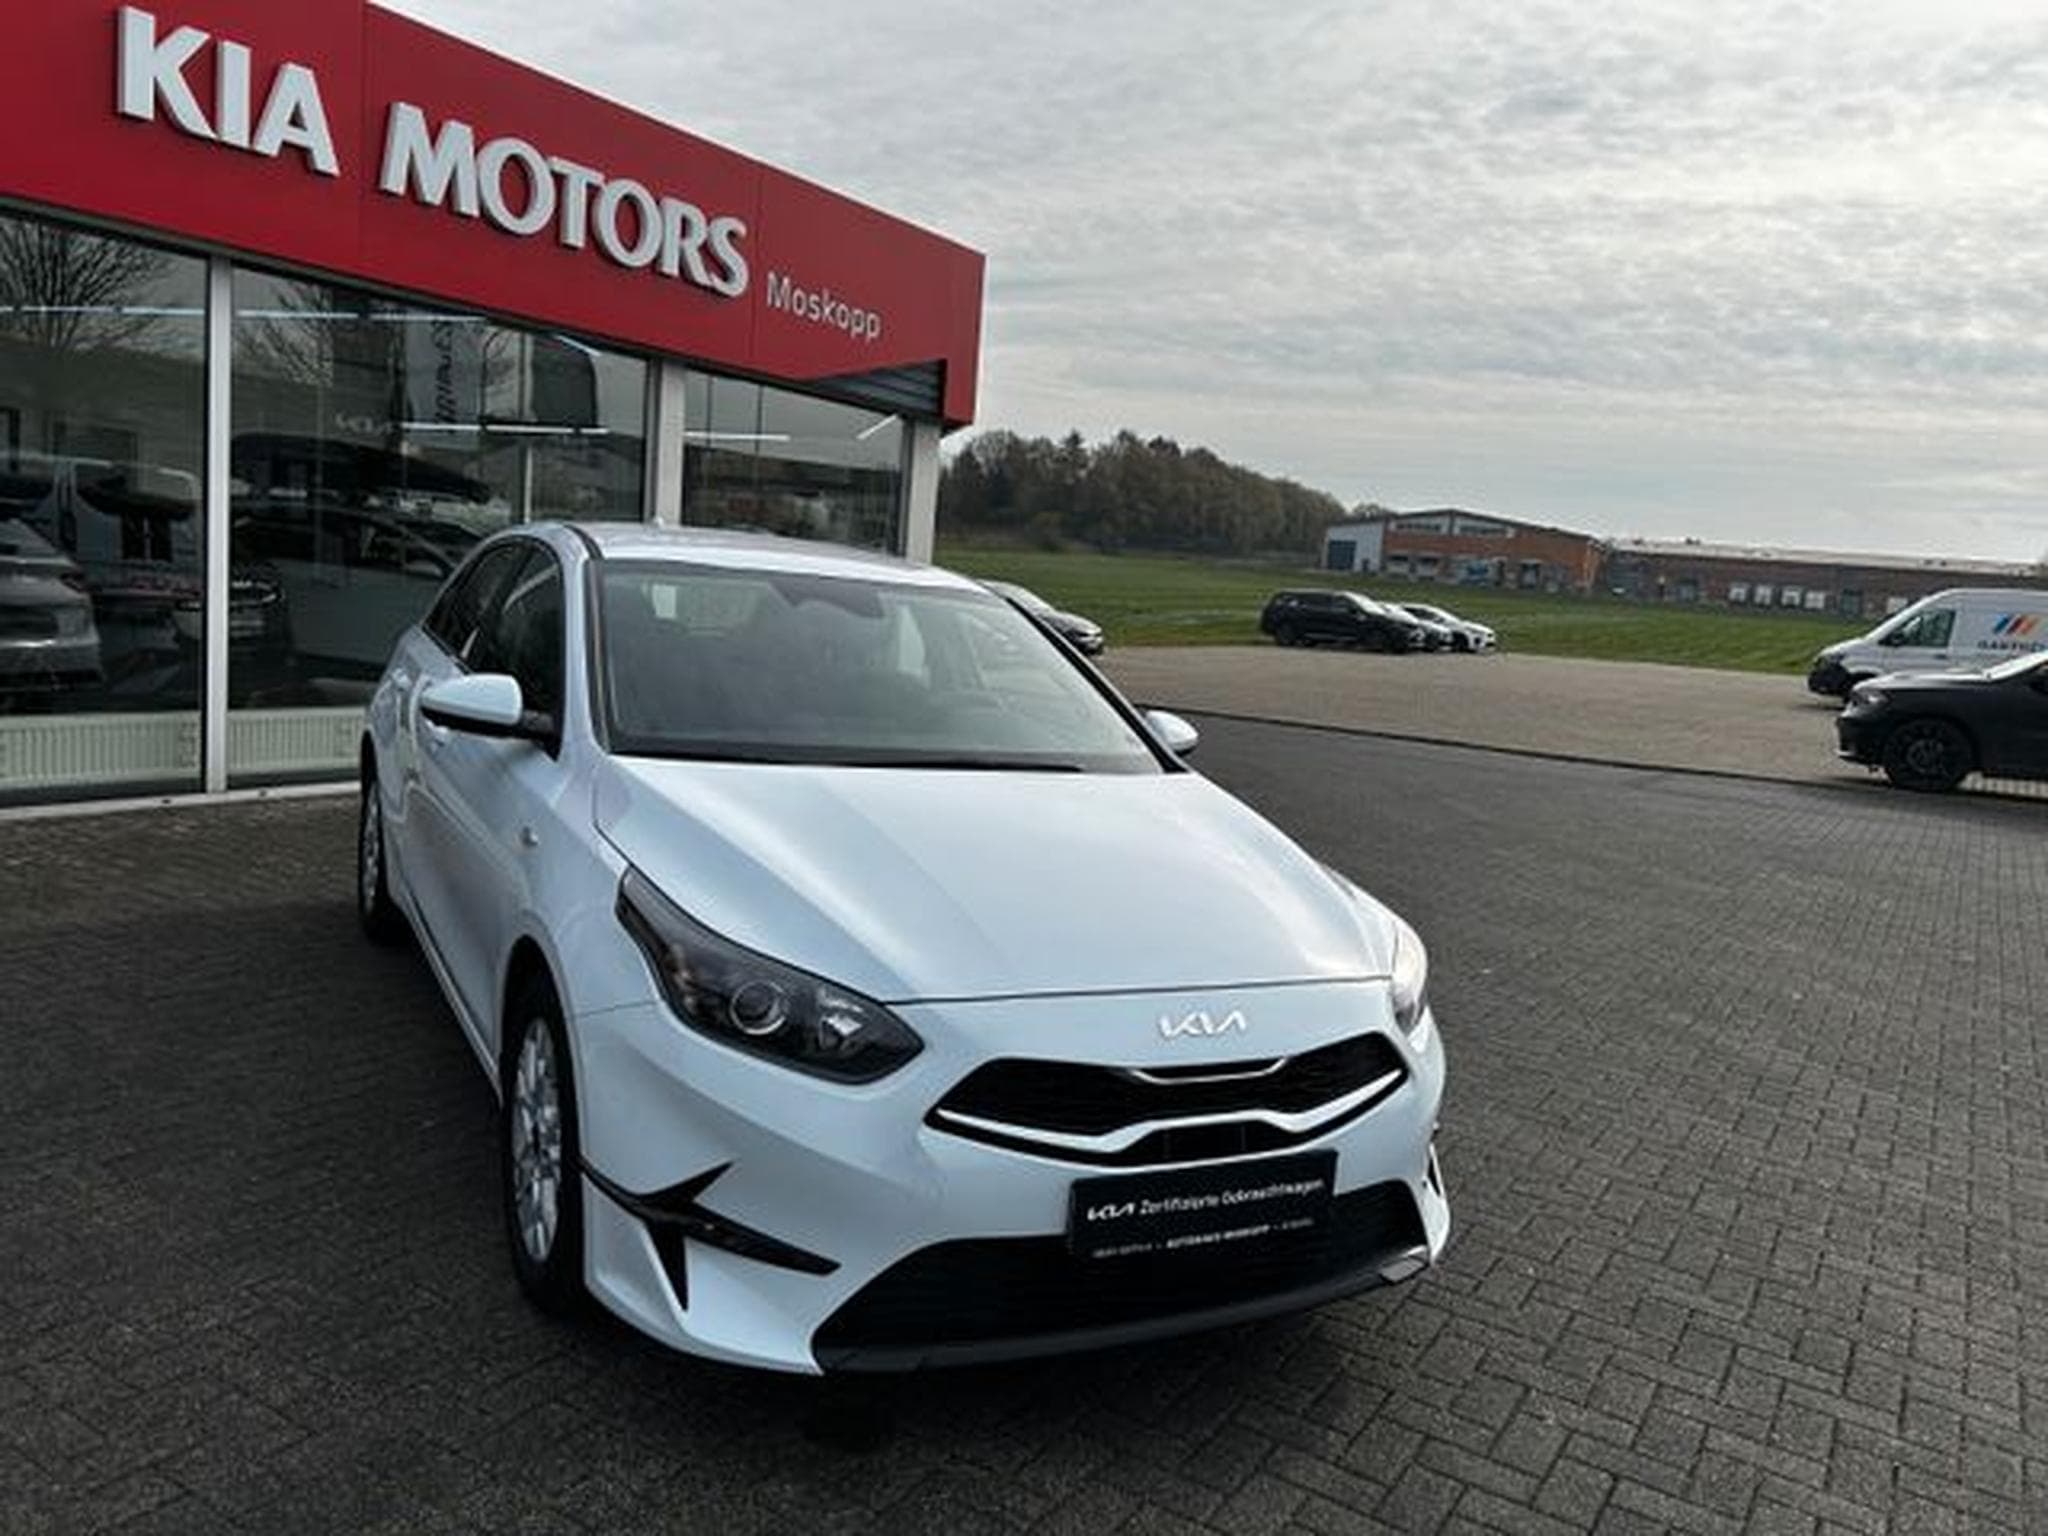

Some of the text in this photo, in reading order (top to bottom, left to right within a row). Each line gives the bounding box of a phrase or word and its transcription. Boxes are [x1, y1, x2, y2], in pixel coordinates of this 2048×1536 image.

[118, 6, 748, 297] KIA MOTORS
[767, 272, 881, 341] Moskopp
[1160, 1010, 1246, 1036] KIA
[1087, 1202, 1136, 1221] KIA
